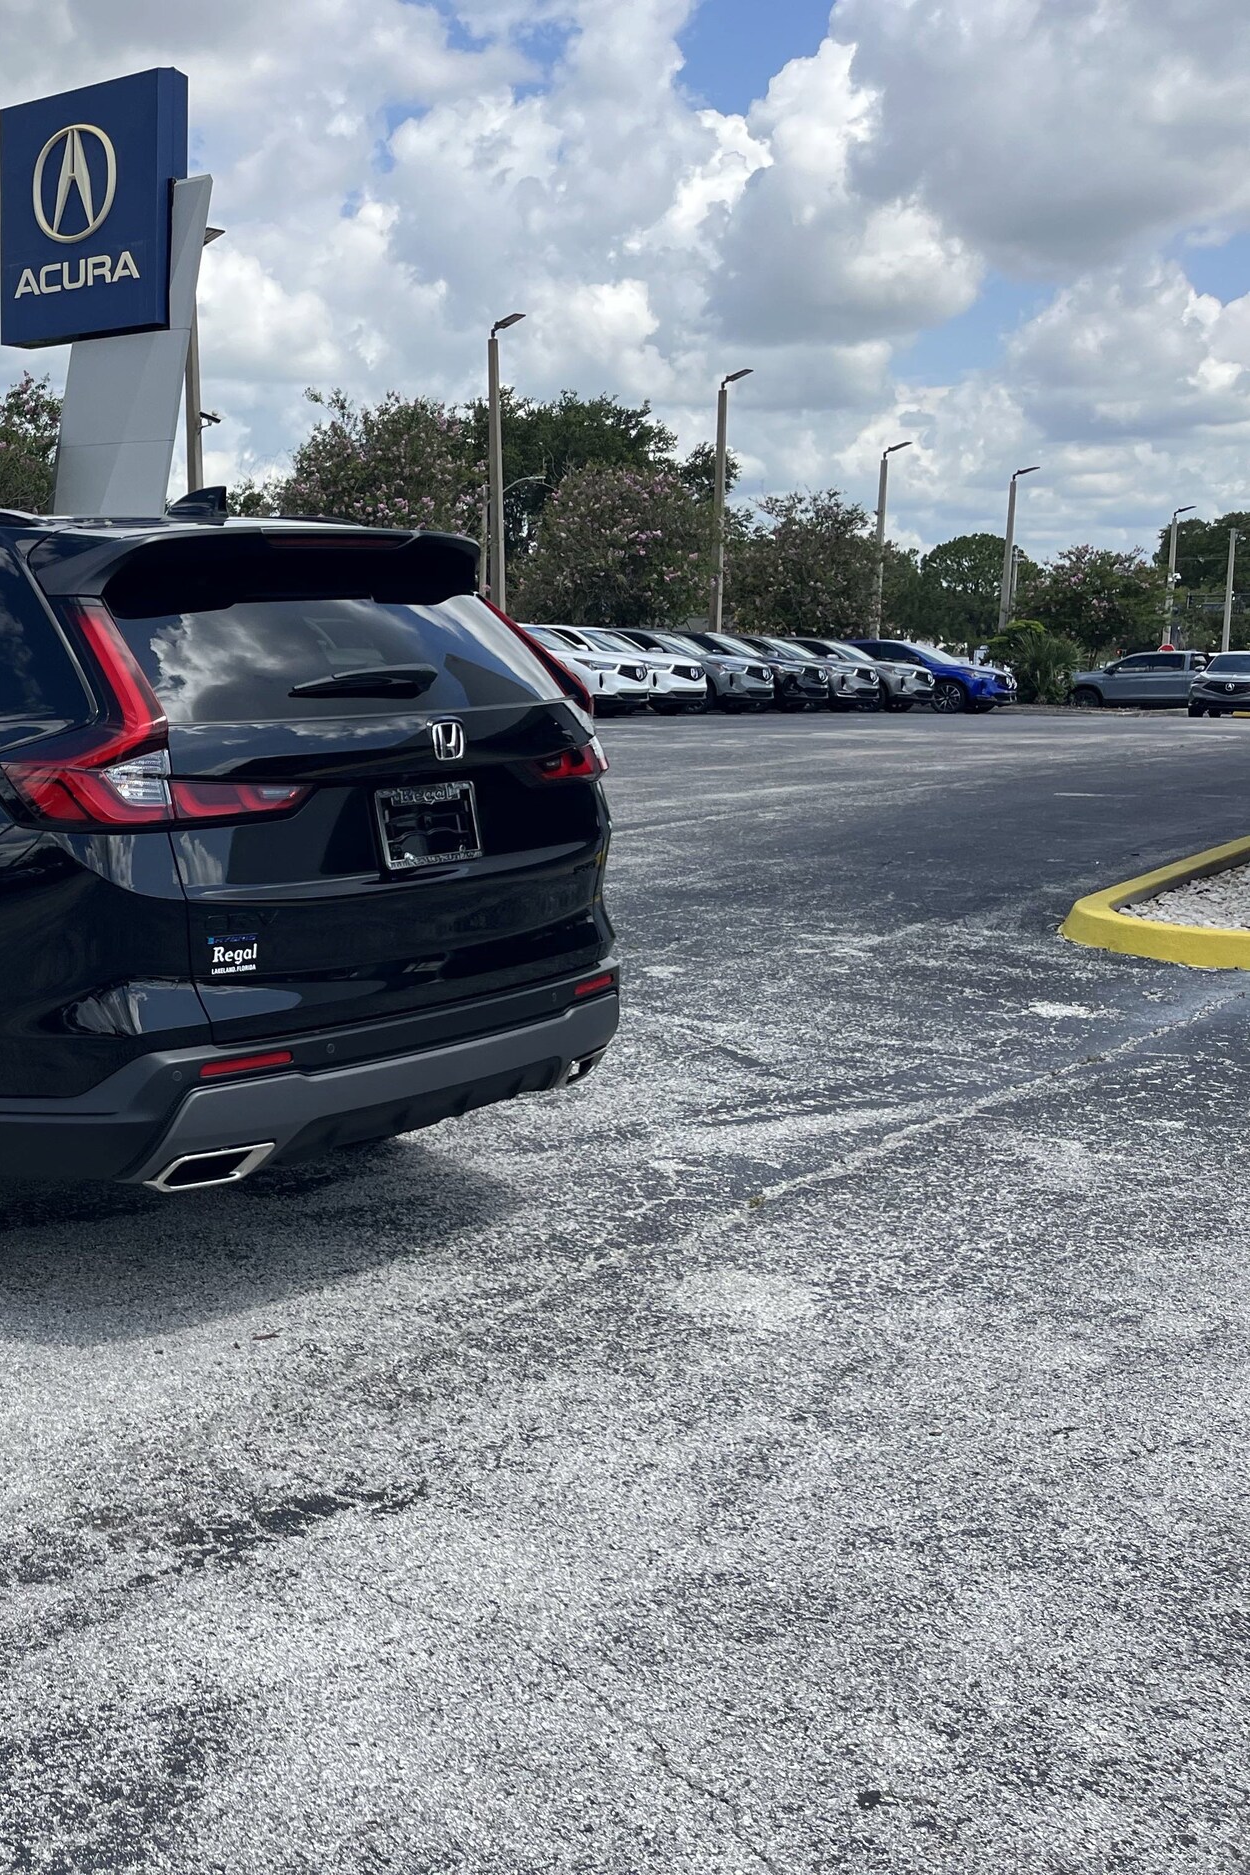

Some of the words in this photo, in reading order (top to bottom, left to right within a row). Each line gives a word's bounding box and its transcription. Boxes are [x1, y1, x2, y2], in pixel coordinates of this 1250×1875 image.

[14, 251, 140, 299] ACURA
[397, 784, 453, 805] Regal
[212, 943, 257, 965] Regal
